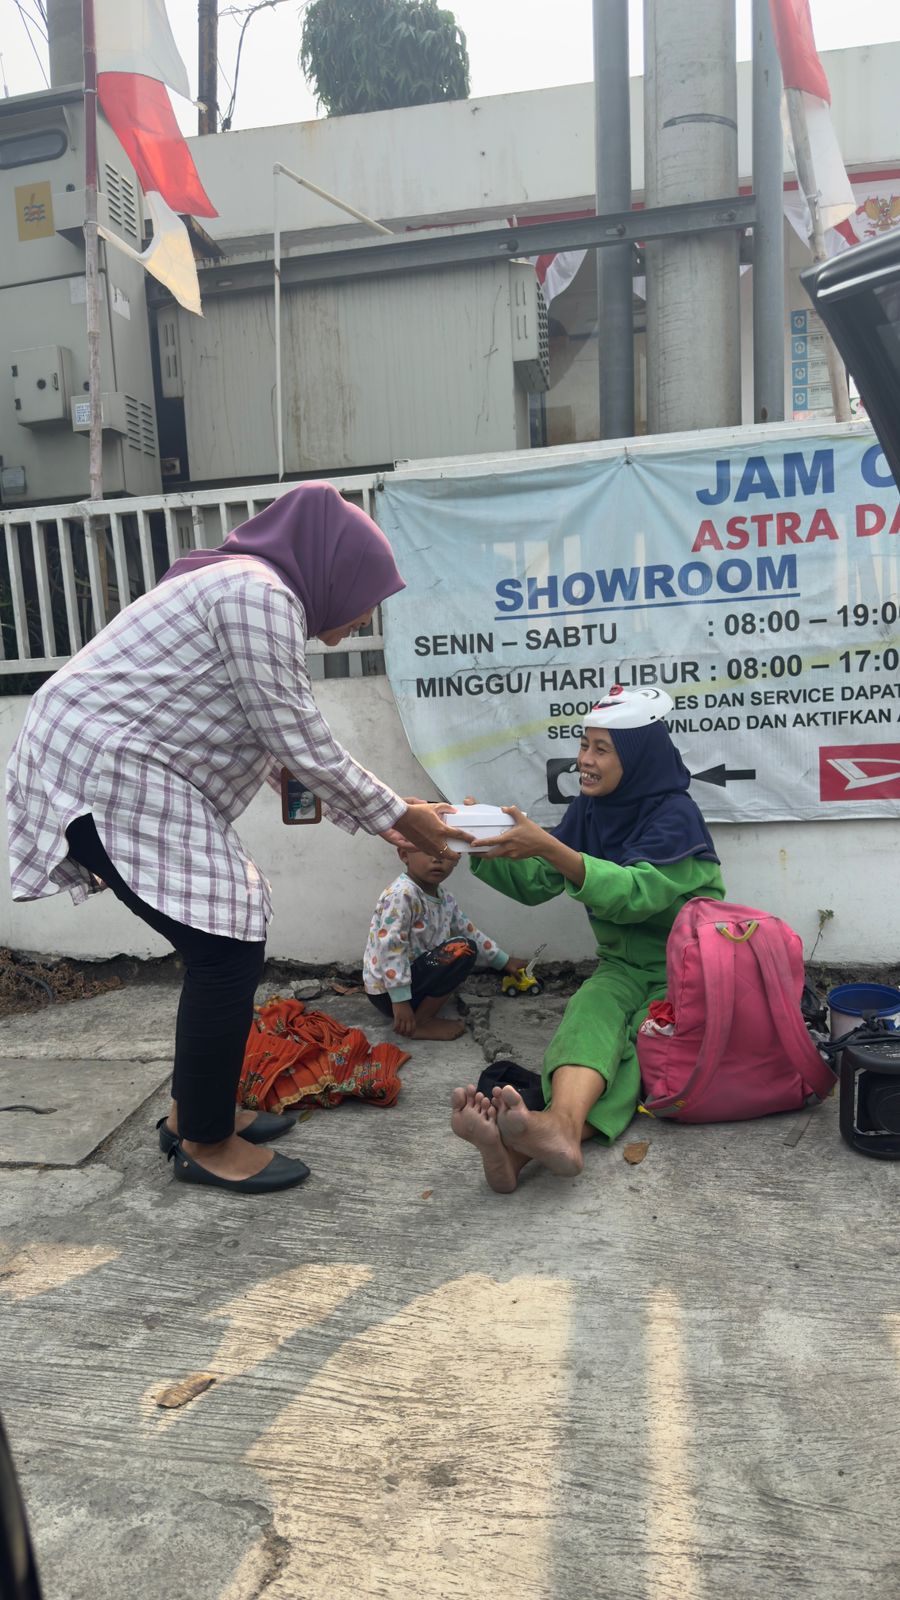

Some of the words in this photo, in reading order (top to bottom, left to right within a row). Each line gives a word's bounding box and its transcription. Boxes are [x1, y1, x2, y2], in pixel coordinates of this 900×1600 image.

[696, 448, 835, 506] JAM
[691, 508, 839, 552] ASTRA
[495, 554, 797, 612] SHOWROOM
[414, 632, 494, 656] SENIN
[525, 622, 617, 650] SABTU
[724, 609, 800, 636] 08:00
[837, 601, 900, 627] 19:0
[416, 671, 531, 698] MINGGU/
[540, 667, 604, 692] HARI
[614, 661, 700, 687] LIBUR
[727, 654, 802, 680] 08:00
[705, 692, 744, 709] DAN
[751, 687, 834, 706] SERVICE
[841, 683, 900, 701] DAPAT
[747, 714, 787, 730] DAN
[792, 708, 891, 728] AKTIFKAN
